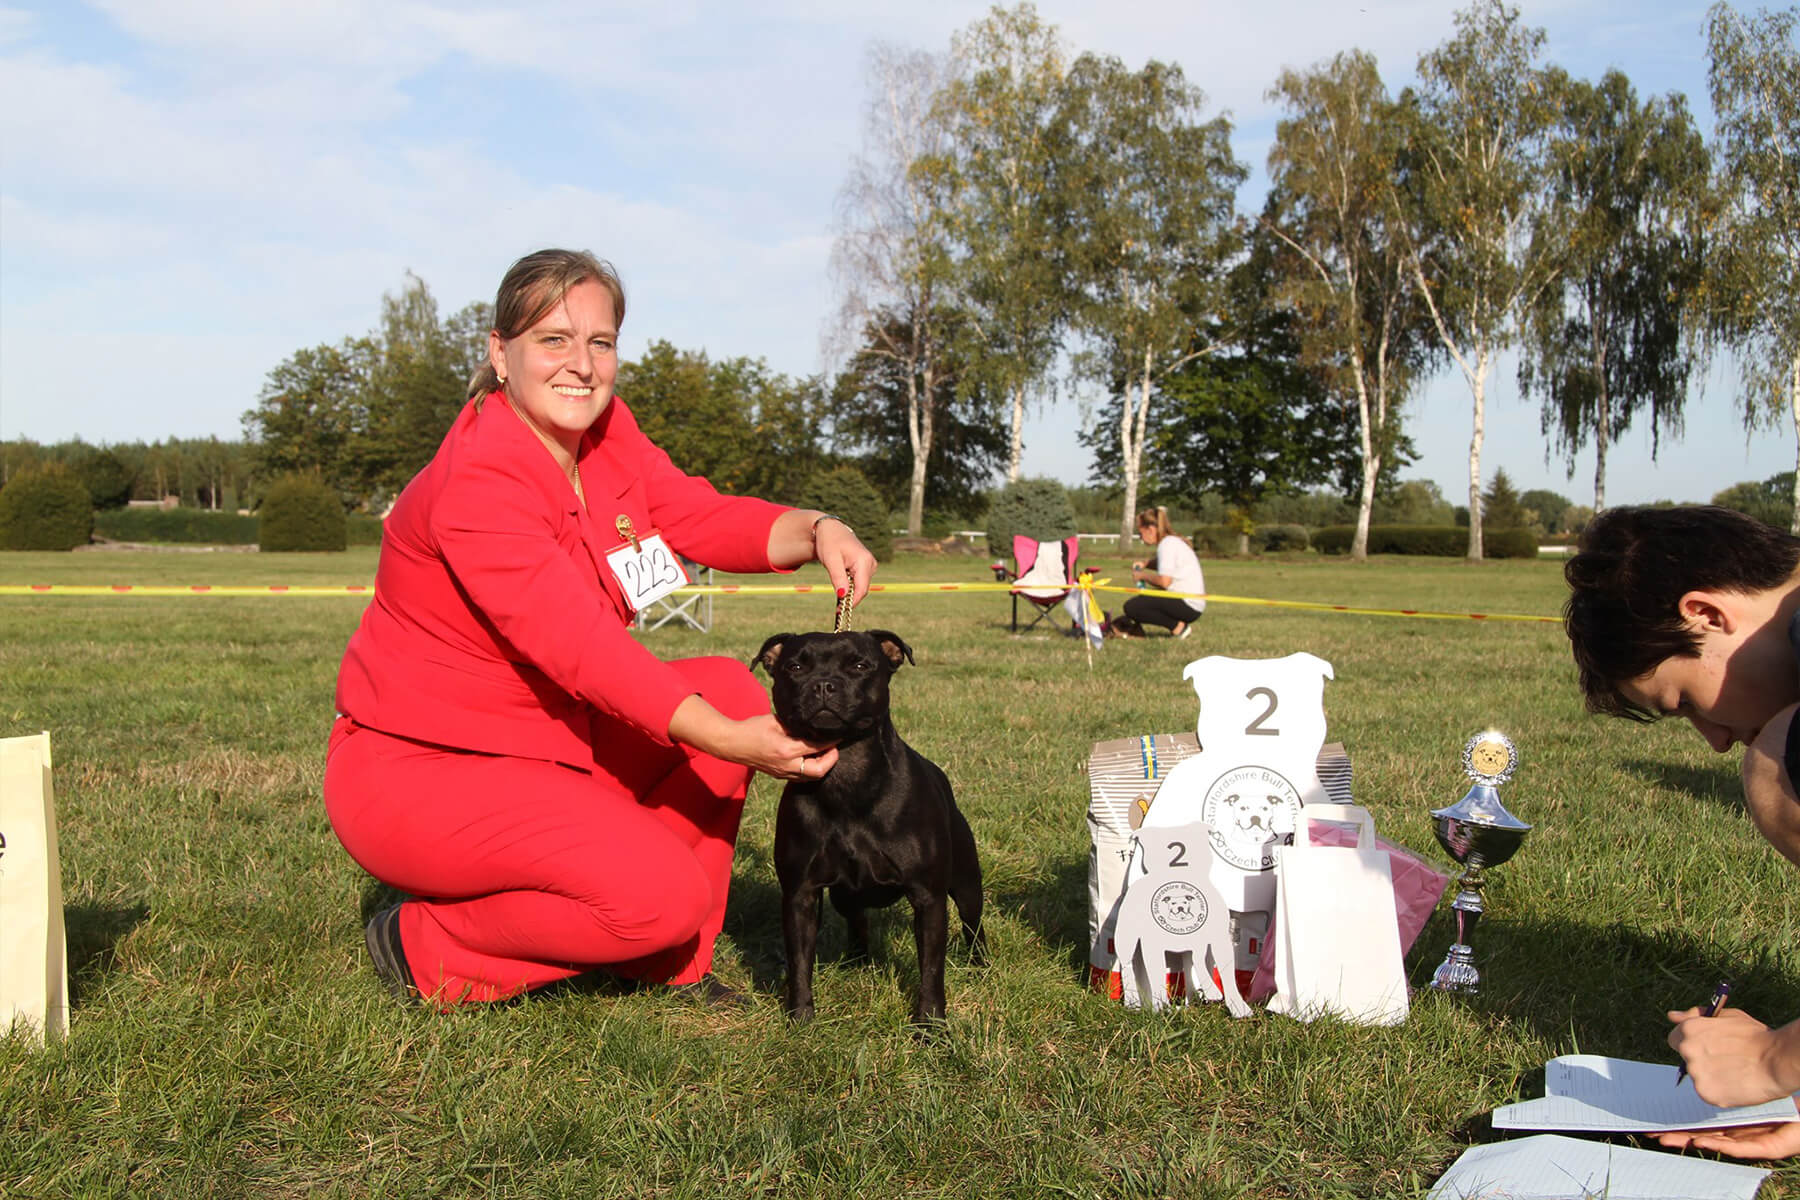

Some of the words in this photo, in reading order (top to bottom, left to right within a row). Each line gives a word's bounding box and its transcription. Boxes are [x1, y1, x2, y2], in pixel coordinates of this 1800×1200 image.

[625, 548, 678, 597] 223
[1245, 686, 1280, 736] 2
[1207, 771, 1257, 826] Staffordshire
[1261, 771, 1285, 789] Bull
[1167, 842, 1189, 867] 2
[1223, 848, 1258, 867] Czech
[1261, 850, 1279, 866] Clu
